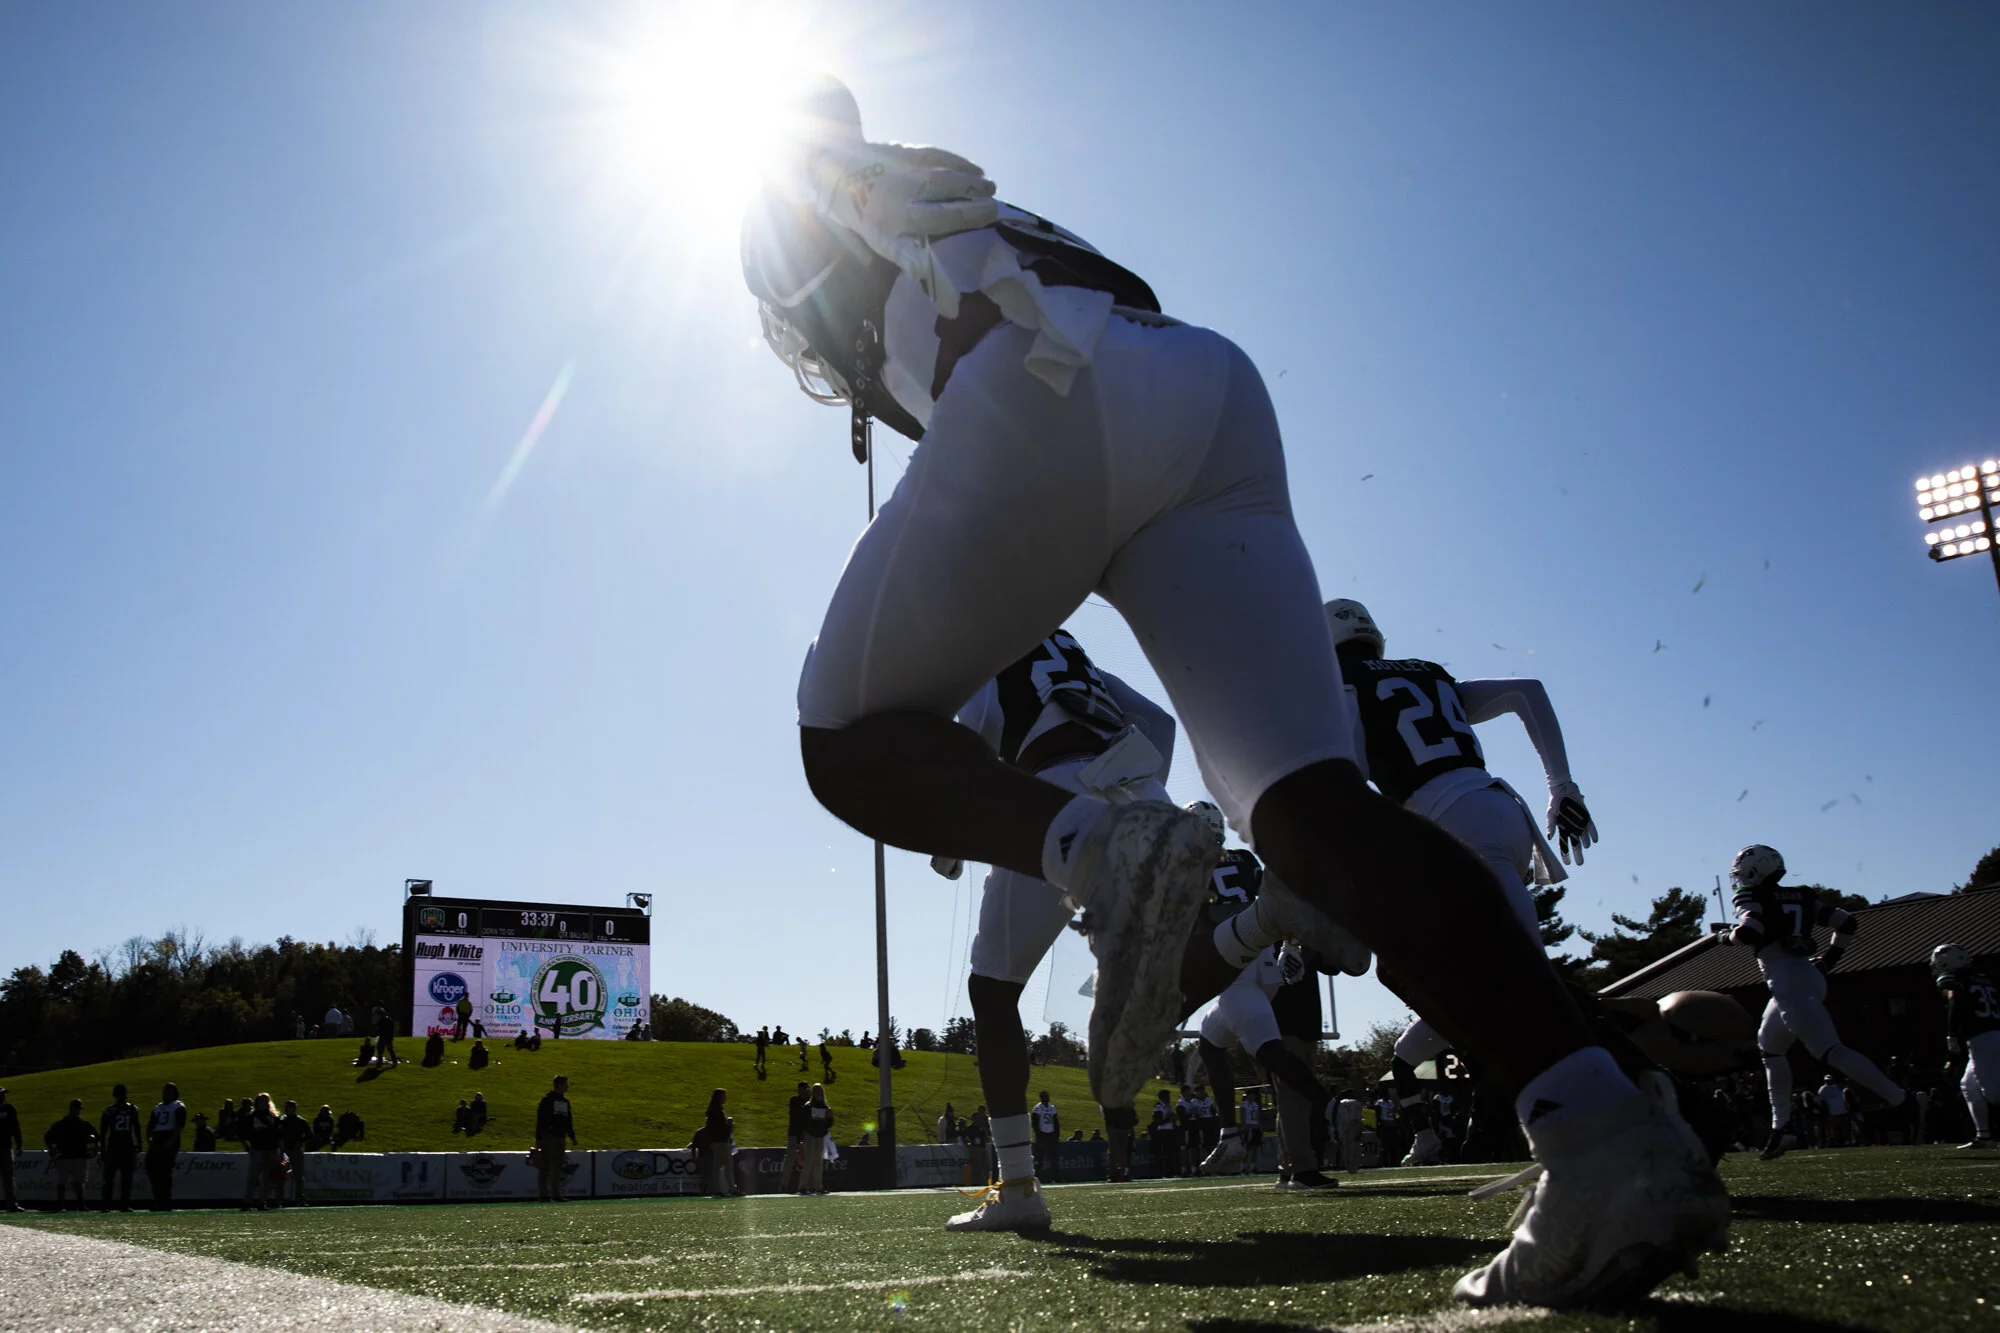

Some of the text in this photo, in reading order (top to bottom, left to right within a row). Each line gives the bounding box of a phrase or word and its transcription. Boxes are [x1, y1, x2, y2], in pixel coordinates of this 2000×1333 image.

[1375, 676, 1483, 768] 24
[457, 911, 468, 929] 0
[520, 911, 556, 927] 33:37
[559, 920, 567, 932] 0
[606, 919, 615, 936] 0
[1781, 903, 1804, 937] 7
[416, 942, 483, 960] Hugh White
[501, 941, 633, 956] UNIVERSITY PARTNER
[433, 977, 465, 1001] Kroger
[485, 1004, 521, 1015] OHIO
[538, 1011, 596, 1025] ANNERSARY
[613, 1008, 647, 1018] OHIO
[1445, 1054, 1471, 1079] 2
[186, 1157, 238, 1176] future.
[611, 1181, 658, 1193] heating
[662, 1181, 671, 1191] &
